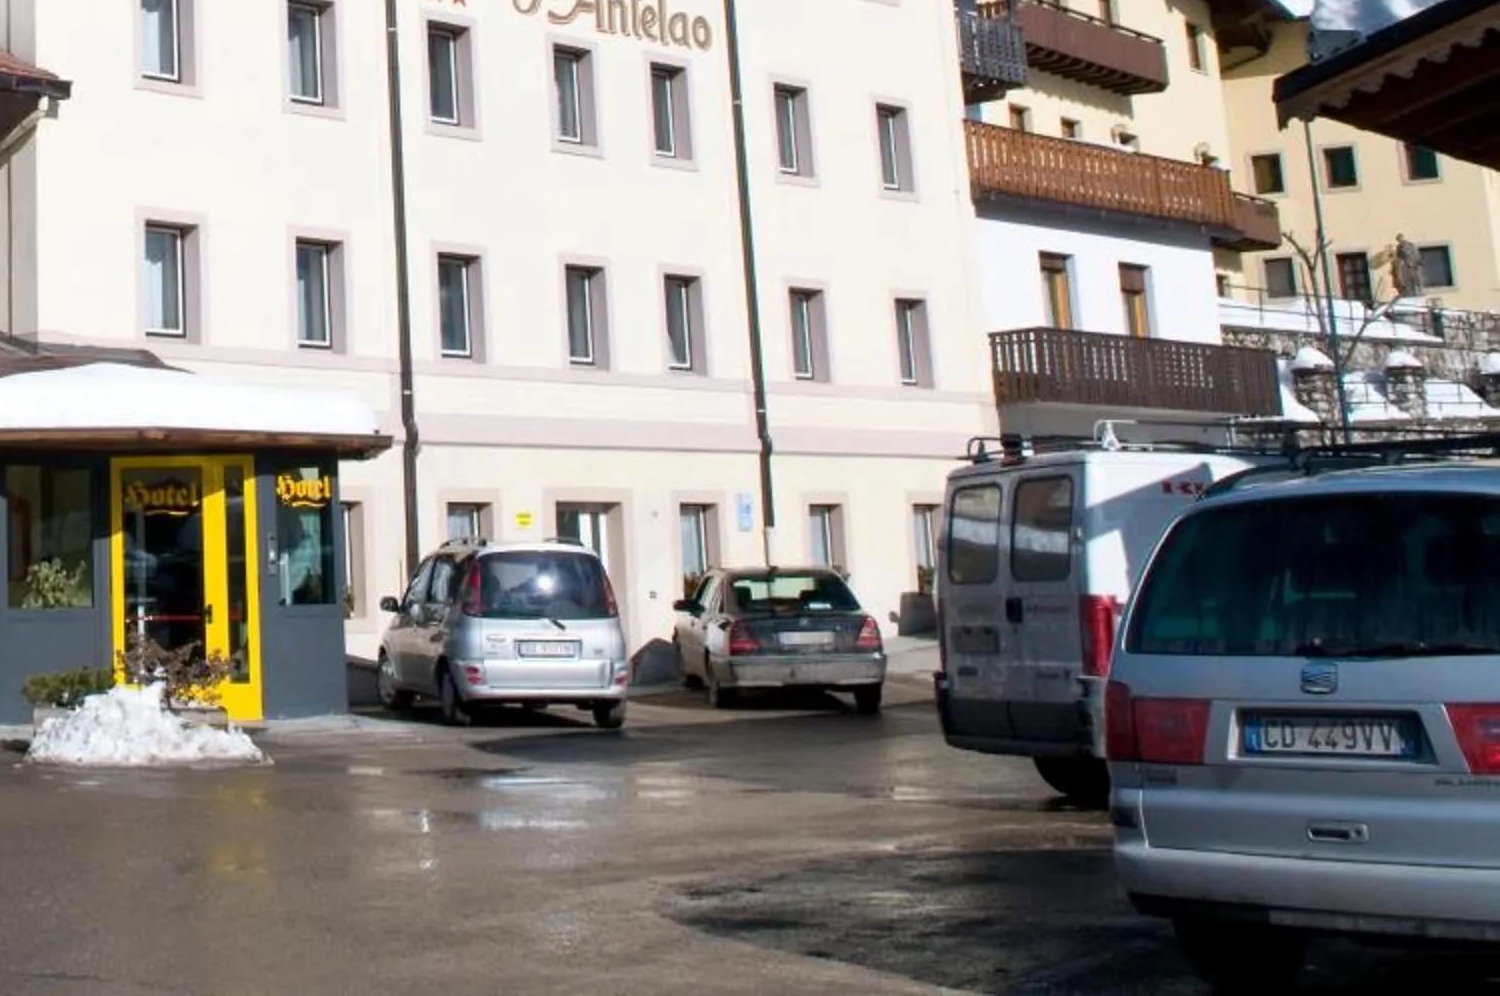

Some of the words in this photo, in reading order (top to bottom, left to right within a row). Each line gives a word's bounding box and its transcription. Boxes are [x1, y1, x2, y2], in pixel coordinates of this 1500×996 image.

[125, 480, 198, 509] Hotel
[276, 474, 331, 503] Hotel
[1264, 719, 1296, 748] CD
[1307, 720, 1394, 751] 449VV
